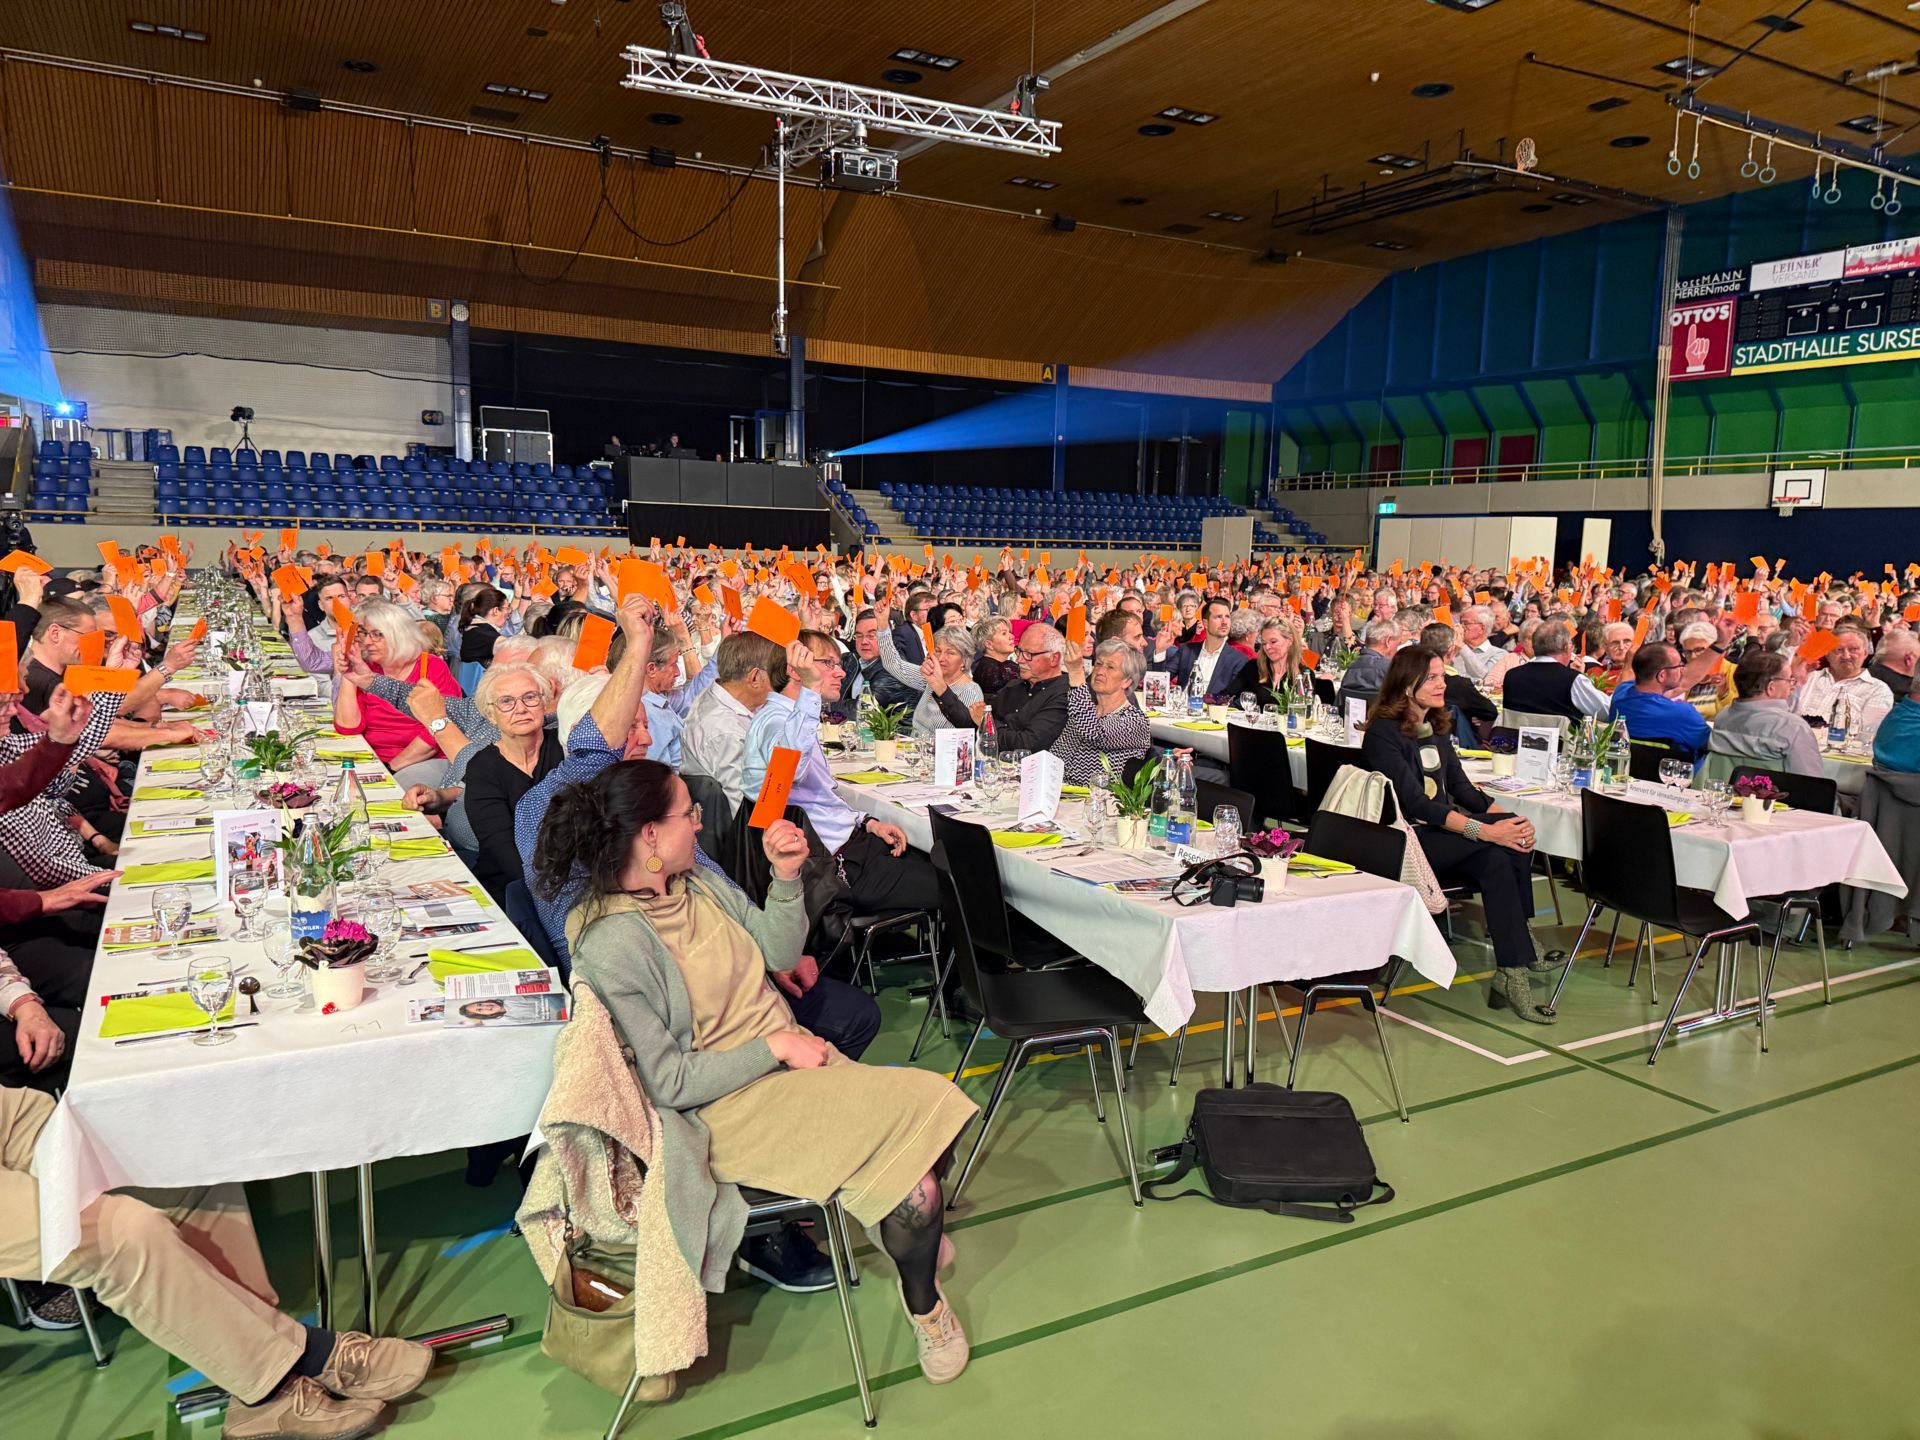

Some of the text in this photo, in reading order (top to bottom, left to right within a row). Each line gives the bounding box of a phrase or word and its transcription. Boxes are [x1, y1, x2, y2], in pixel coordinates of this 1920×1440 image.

[1870, 240, 1908, 251] SURSEE
[1772, 259, 1820, 274] LEHNER
[1772, 269, 1819, 284] VERSAND
[430, 303, 442, 318] B
[1669, 304, 1730, 327] OTTO'S
[1735, 336, 1851, 366] STADTHALLE
[1042, 366, 1053, 380] A
[1177, 848, 1209, 863] Reservi
